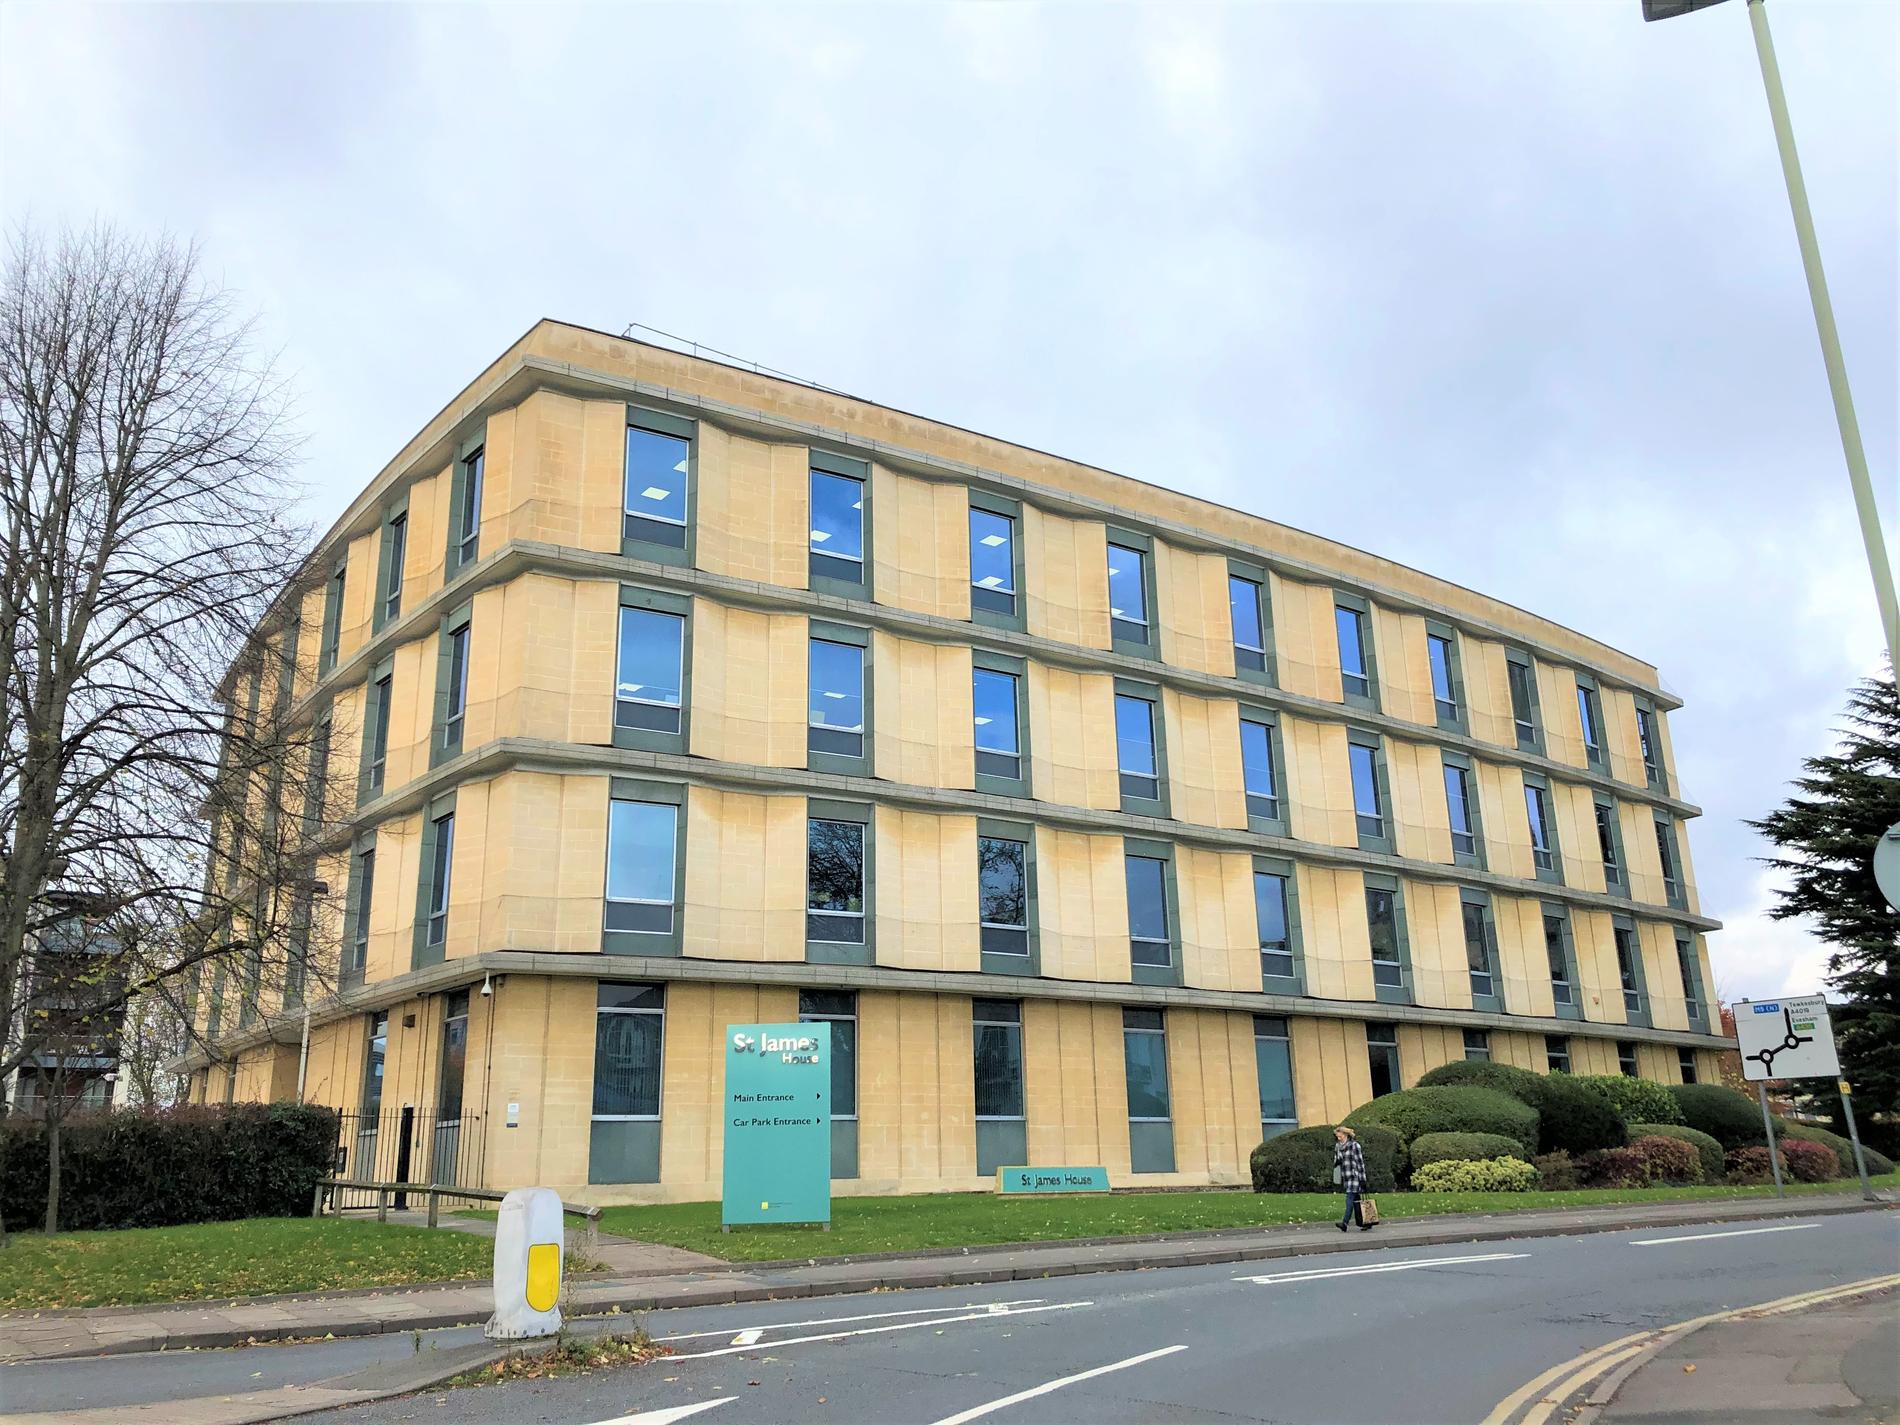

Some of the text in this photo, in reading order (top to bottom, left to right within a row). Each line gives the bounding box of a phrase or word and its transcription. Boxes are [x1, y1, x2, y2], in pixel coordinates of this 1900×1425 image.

[734, 1033, 818, 1057] St James
[782, 1052, 819, 1064] House
[733, 1093, 794, 1103] Main Entrance
[733, 1117, 811, 1126] Car Park Entrance
[1021, 1174, 1093, 1188] St James House
